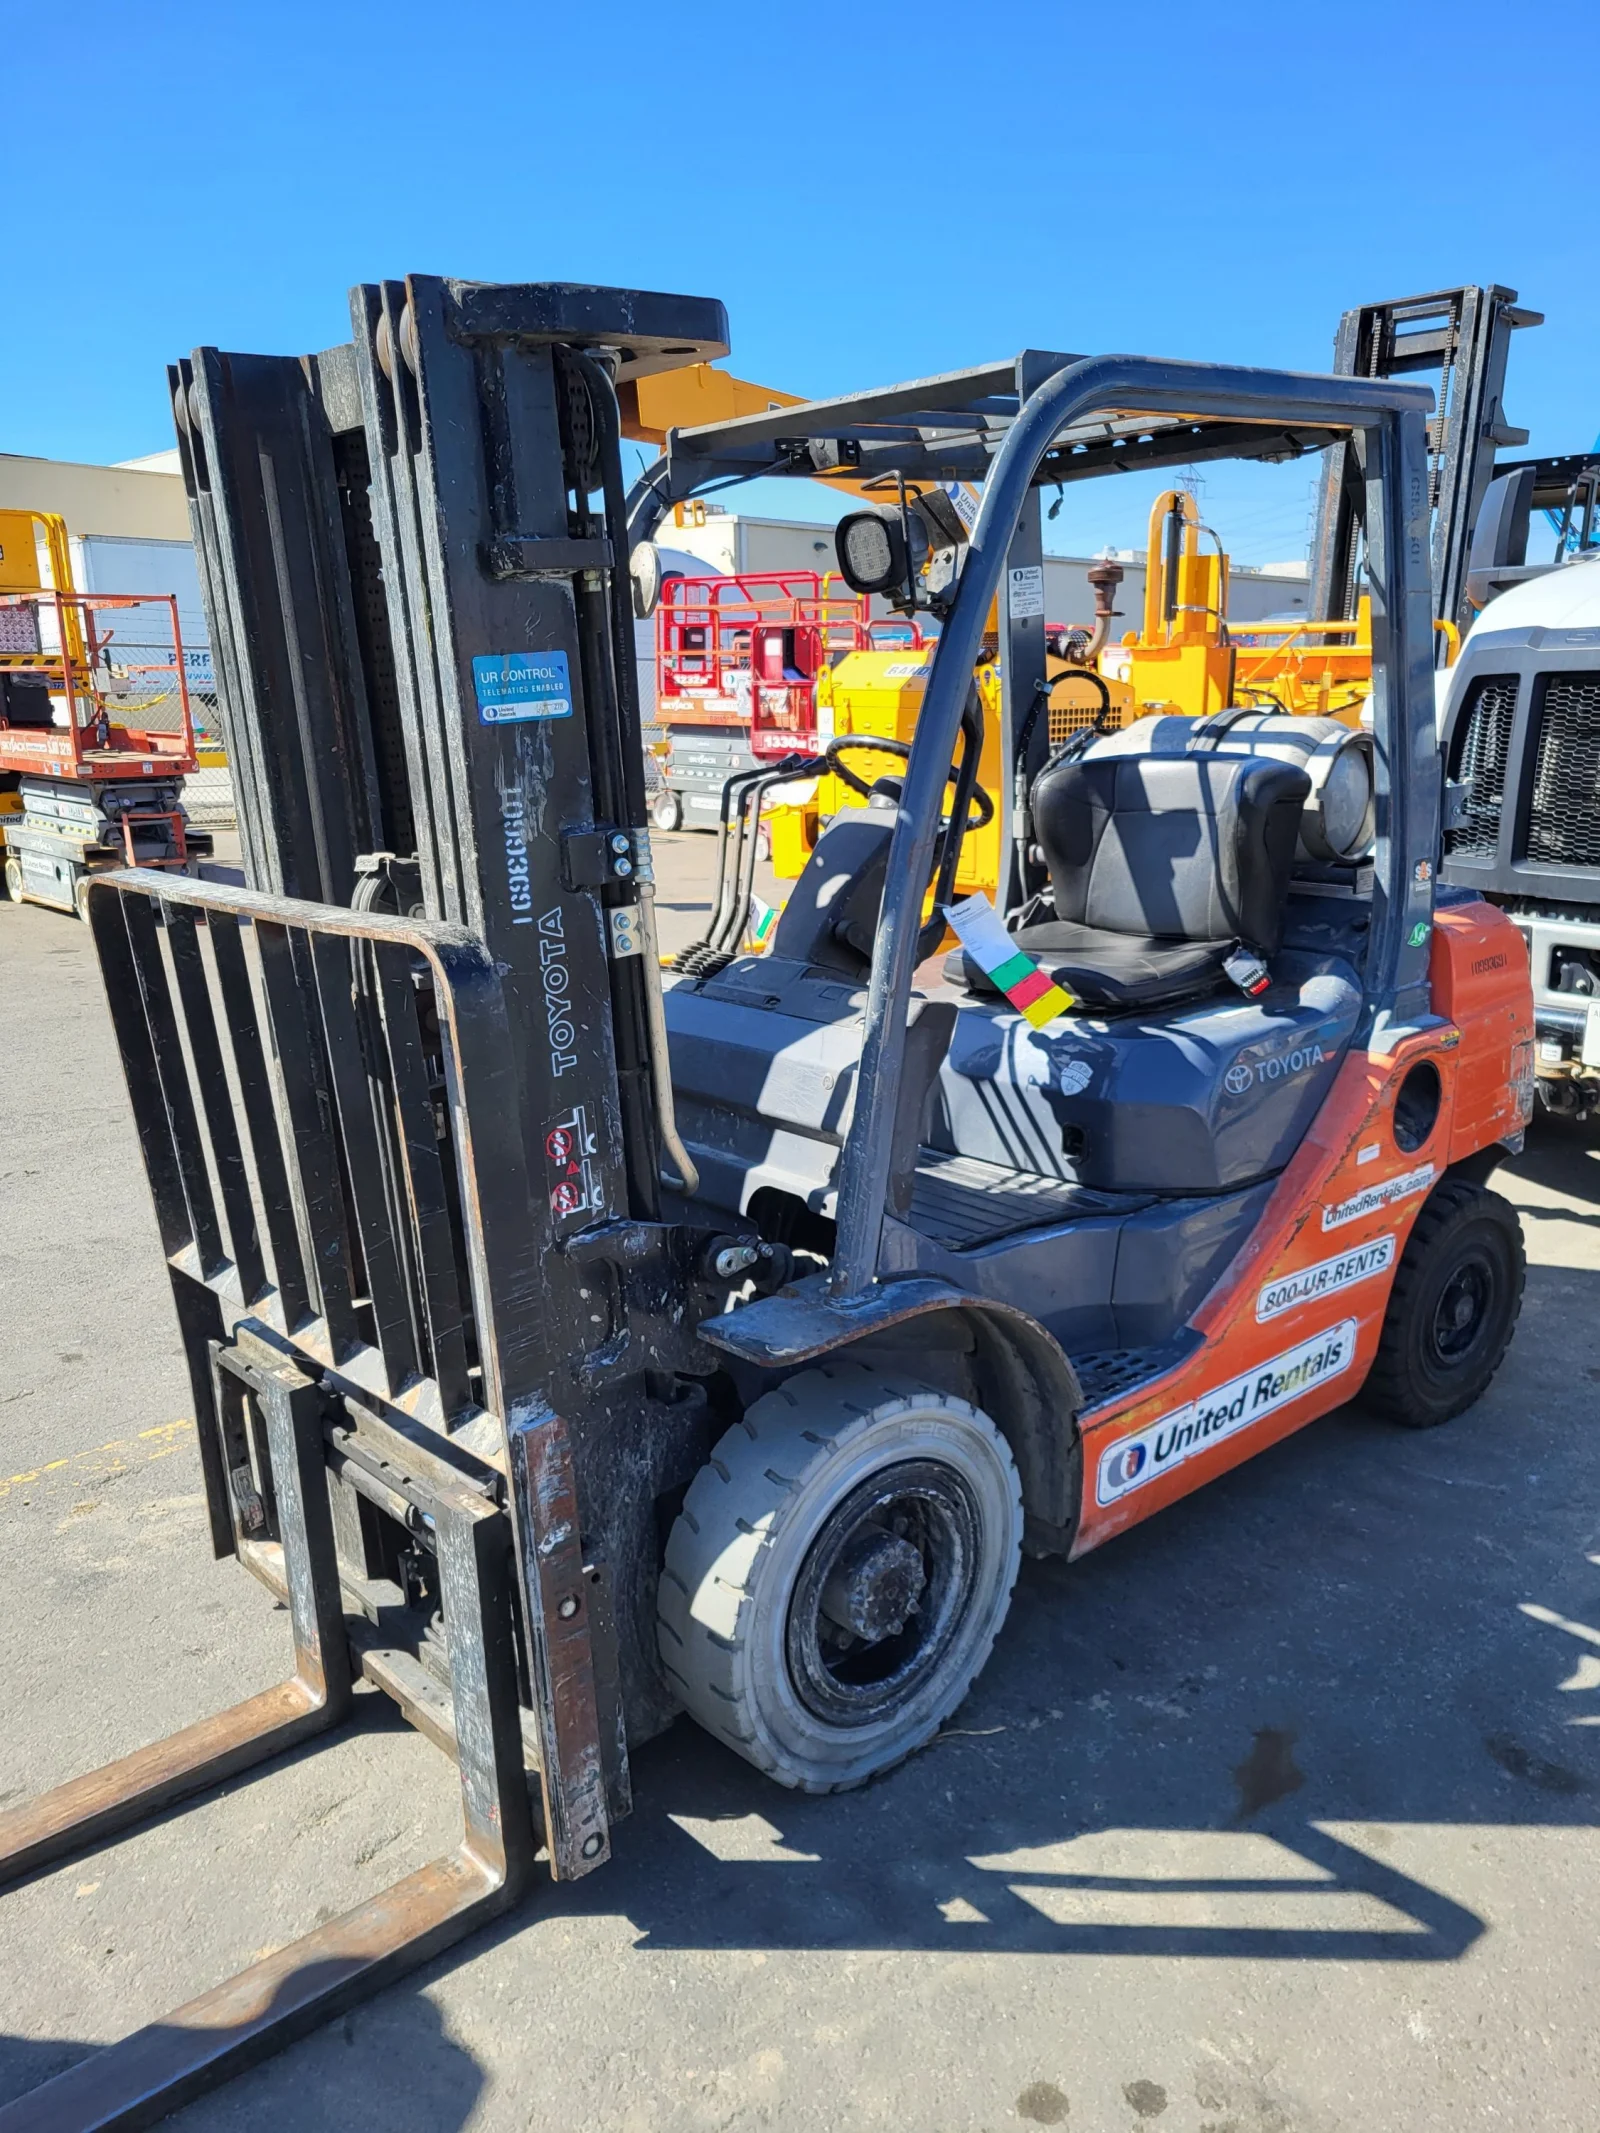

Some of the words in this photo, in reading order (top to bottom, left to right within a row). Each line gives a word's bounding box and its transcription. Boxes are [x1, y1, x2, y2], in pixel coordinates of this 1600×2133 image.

[480, 671, 498, 684] UR
[501, 667, 556, 682] CONTROL
[887, 666, 931, 676] BAND
[482, 686, 529, 697] TELEMATICS
[532, 682, 564, 693] ENABLED
[0, 815, 22, 824] nited
[1471, 954, 1508, 976] 10993691
[537, 905, 577, 1078] TOYOTA
[1255, 1045, 1326, 1084] TOYOTA
[1264, 1243, 1389, 1314] 800-UR-RENTS
[1153, 1385, 1249, 1463] United
[1254, 1339, 1342, 1409] Rentals
